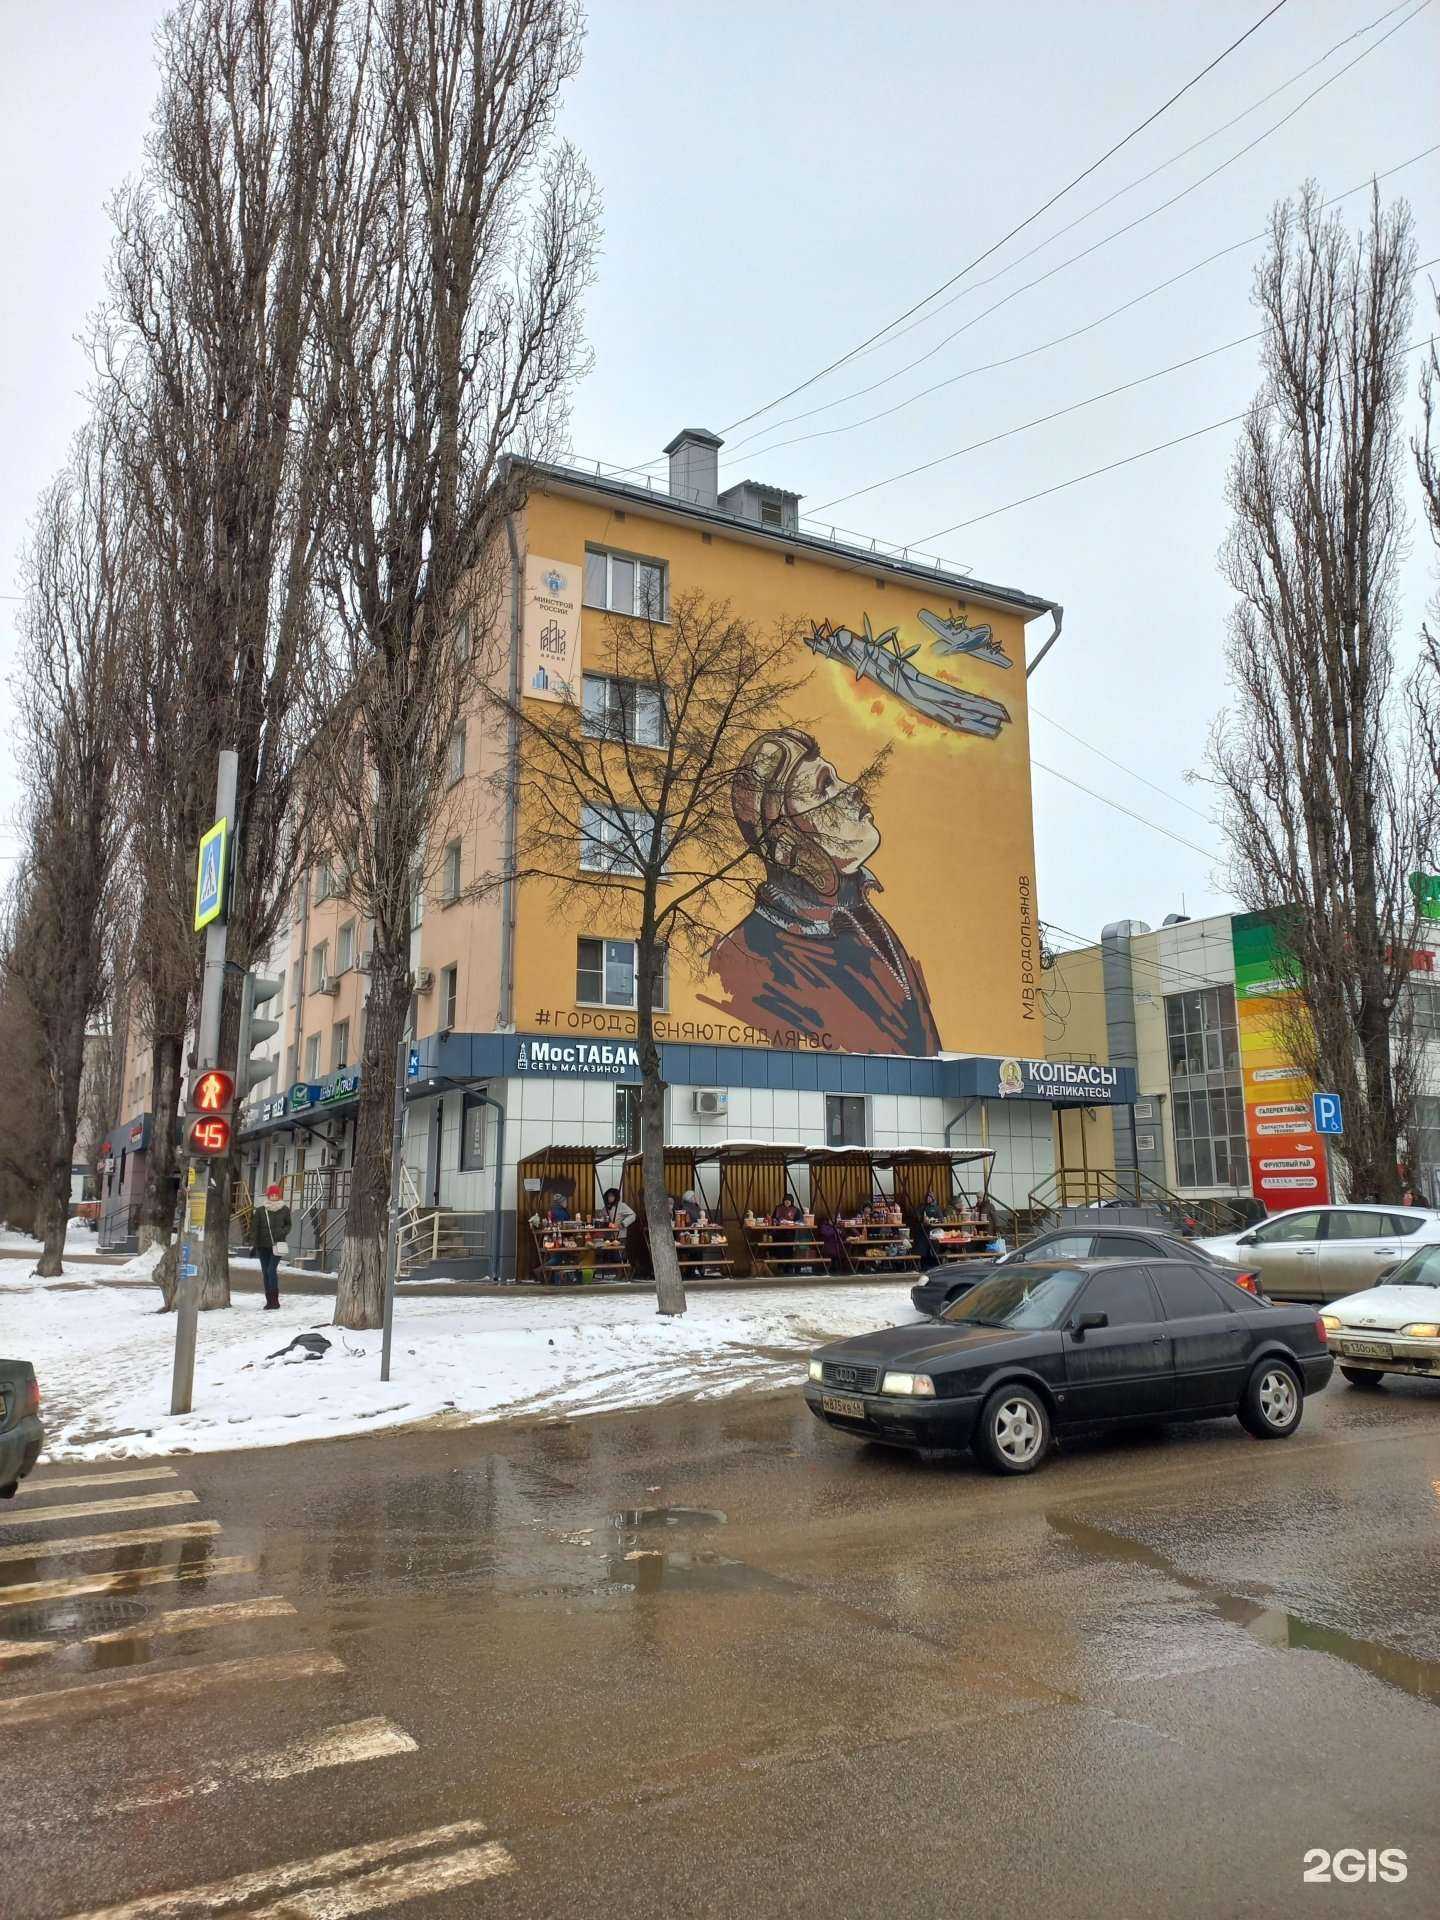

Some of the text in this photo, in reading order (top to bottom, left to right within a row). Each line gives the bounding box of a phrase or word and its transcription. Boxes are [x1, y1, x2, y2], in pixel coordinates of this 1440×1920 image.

[533, 595, 574, 609] МИНСТРОЙ
[539, 604, 569, 615] РОССИИ
[531, 1061, 626, 1075] СЕТЬ МАГАЗИНОВ
[1028, 1061, 1118, 1086] КОЛБАСЫ
[1037, 1084, 1112, 1099] И ДЕЛИКАТЕСЫ
[194, 1123, 224, 1149] 45
